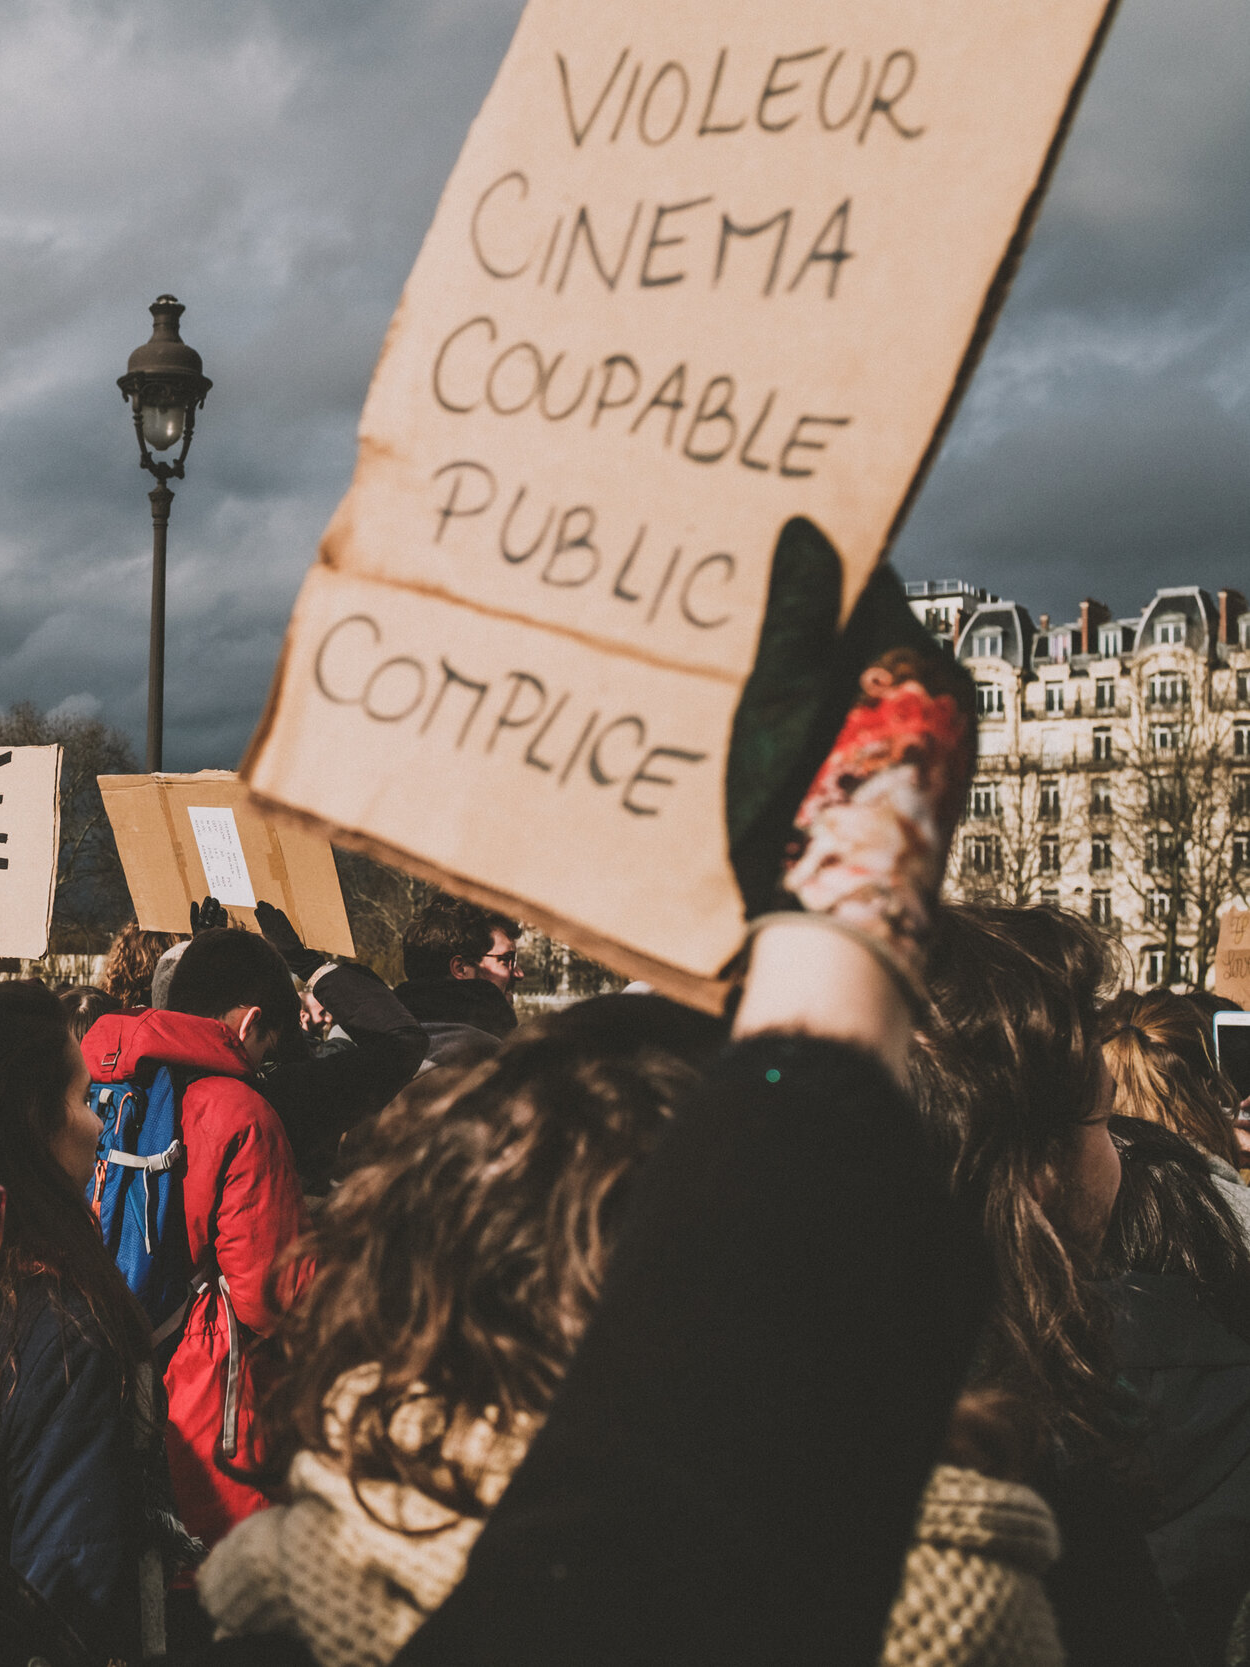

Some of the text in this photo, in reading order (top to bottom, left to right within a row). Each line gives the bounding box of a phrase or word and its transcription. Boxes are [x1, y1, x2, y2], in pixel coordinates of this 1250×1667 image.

[556, 46, 926, 147] VIOLEUR
[470, 171, 858, 300] CINEMA
[432, 316, 851, 479] COUPABLE
[431, 460, 737, 630] PUBLIC
[314, 615, 708, 817] COMPLICE
